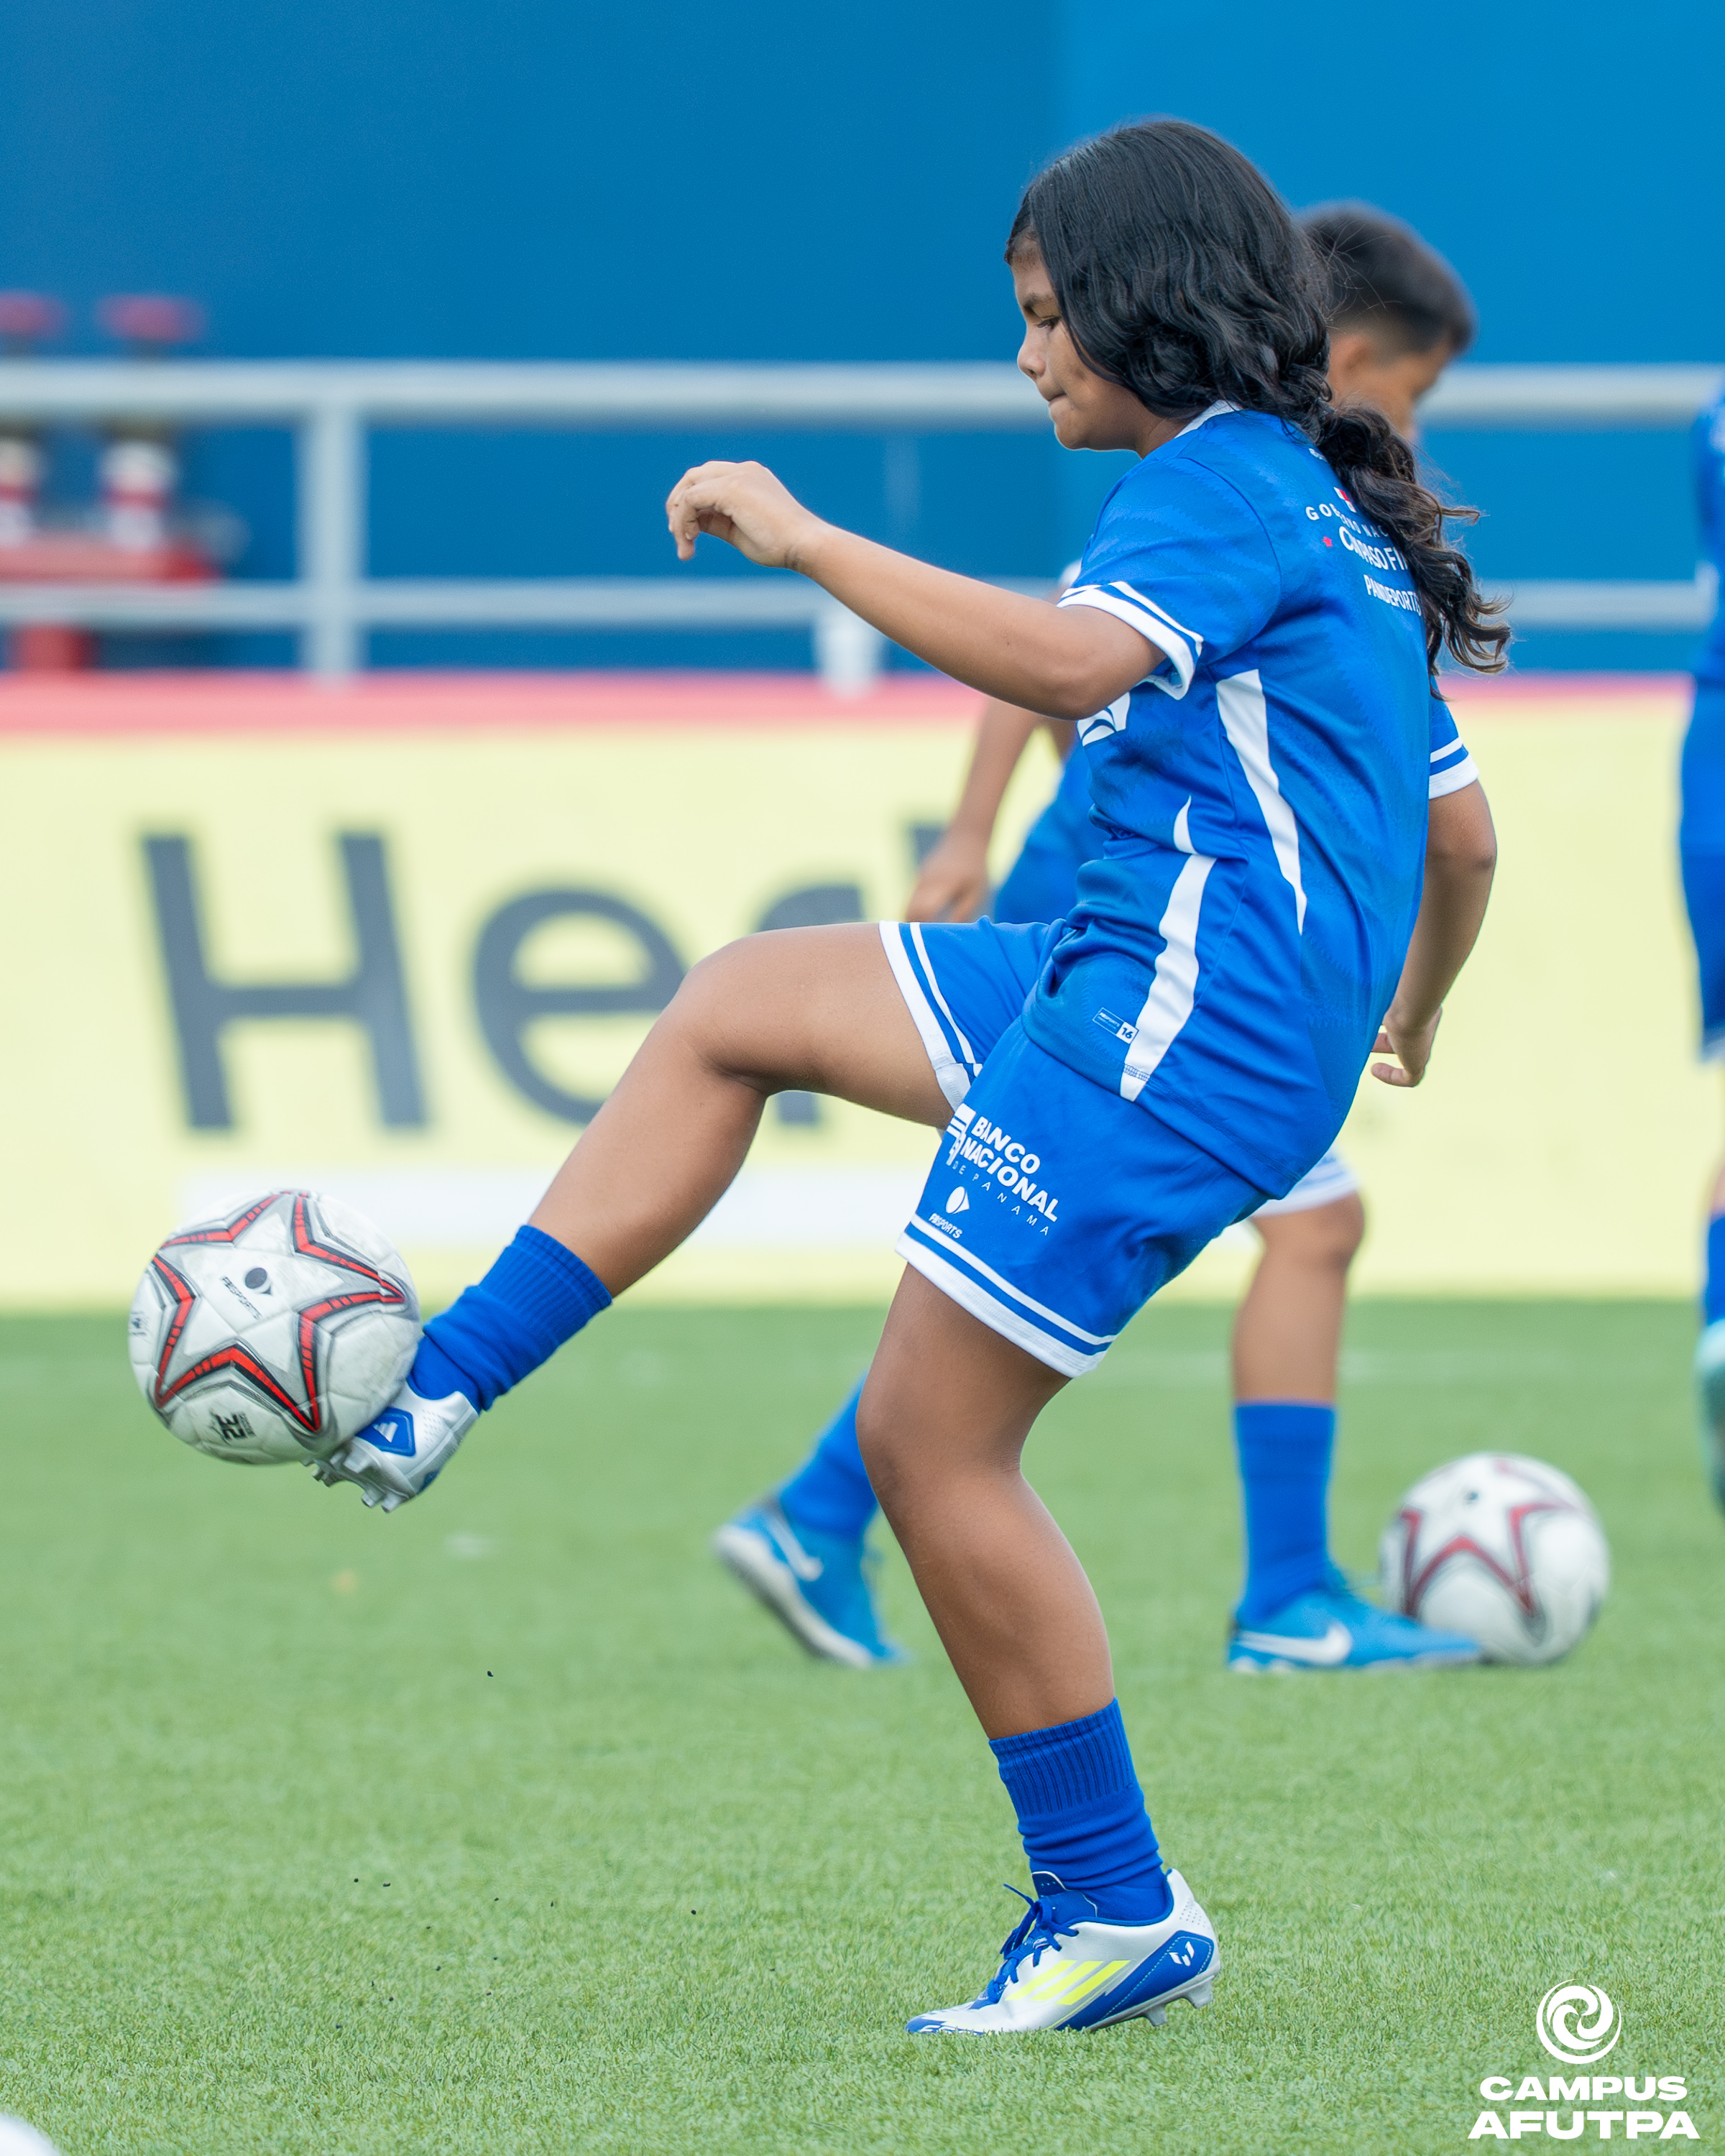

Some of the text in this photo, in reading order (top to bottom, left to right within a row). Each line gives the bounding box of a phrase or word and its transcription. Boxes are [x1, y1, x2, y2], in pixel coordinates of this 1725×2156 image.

[1121, 1027, 1134, 1039] 16
[971, 1116, 1041, 1174] BANCO
[952, 1161, 1049, 1235] DE PANAMA
[960, 1137, 1059, 1222] NACIONAL
